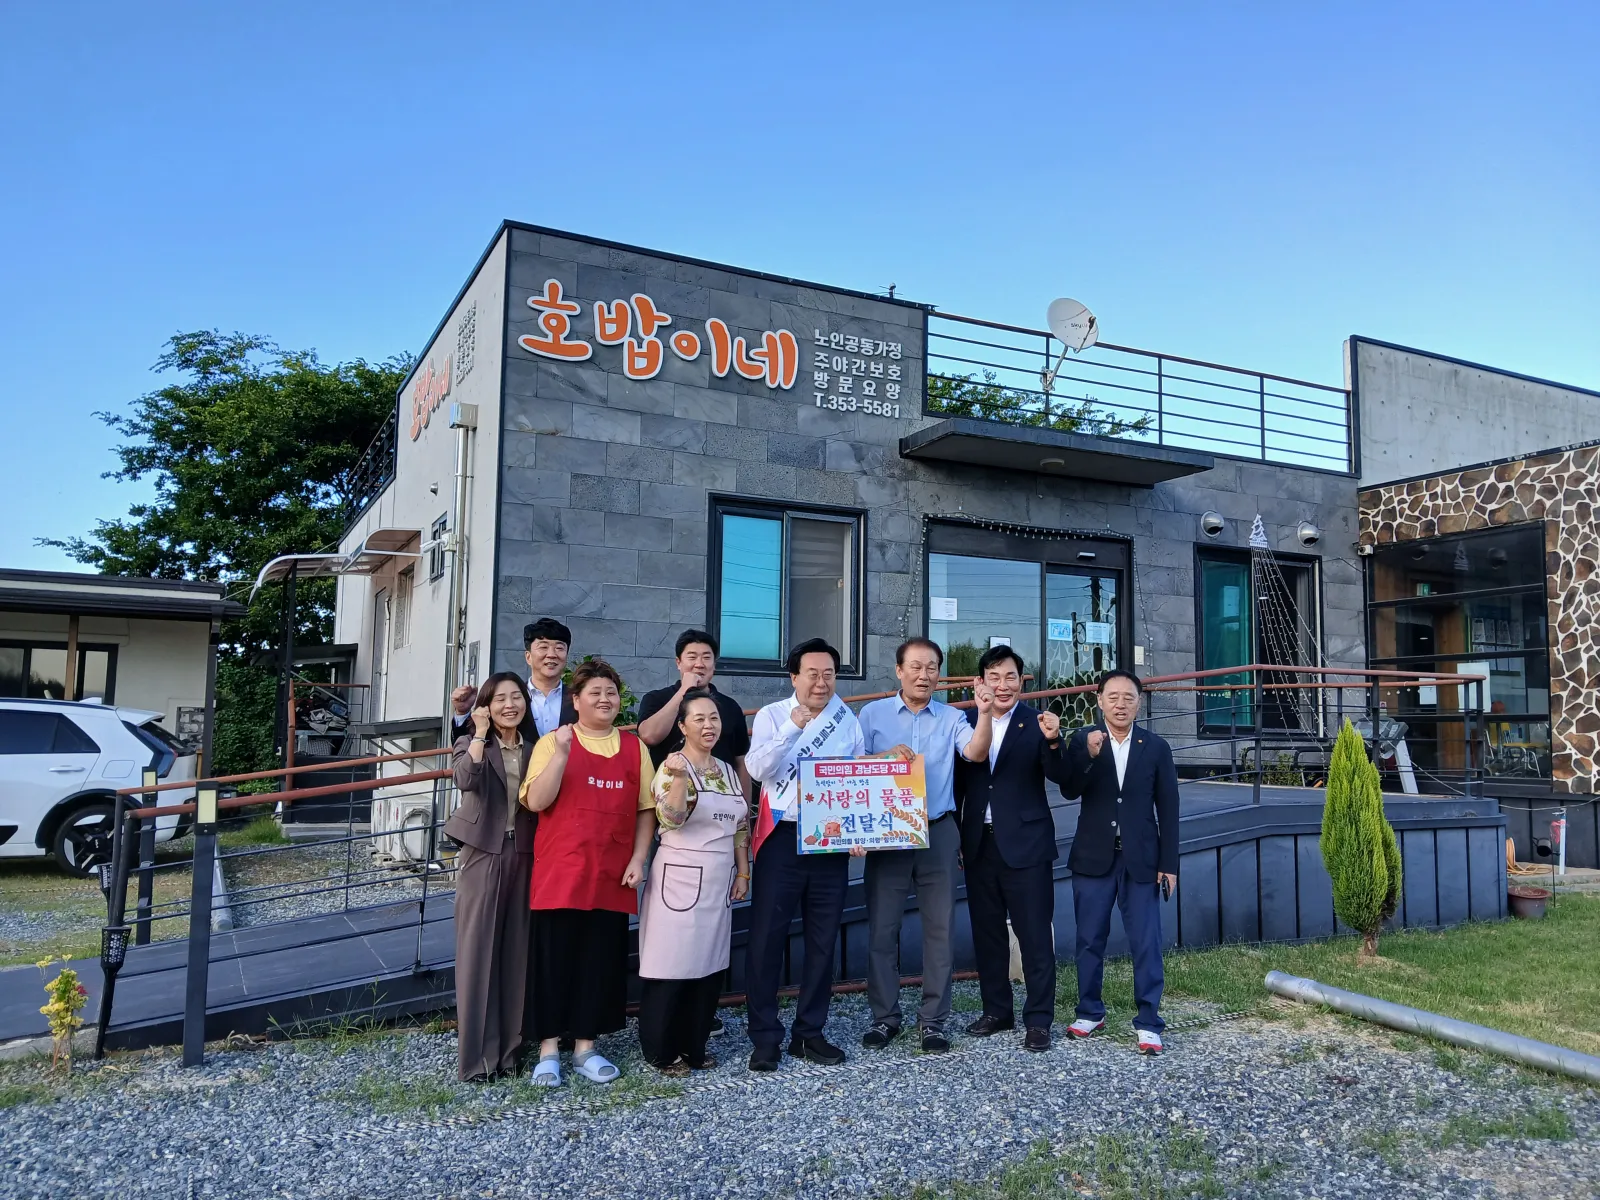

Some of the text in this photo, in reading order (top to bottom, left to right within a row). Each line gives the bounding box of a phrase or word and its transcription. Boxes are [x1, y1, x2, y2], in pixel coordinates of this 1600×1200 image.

[518, 278, 799, 390] 호밥이네
[814, 329, 902, 360] 노인공동가정
[813, 351, 902, 380] 주야간보호
[813, 371, 901, 400] 방문요양
[813, 392, 900, 418] T.353-5581
[811, 720, 837, 750] 가득한
[818, 762, 908, 776] 국민의힘 경남도당 지원
[817, 788, 916, 811] 사랑의 물품
[841, 812, 894, 833] 전달식
